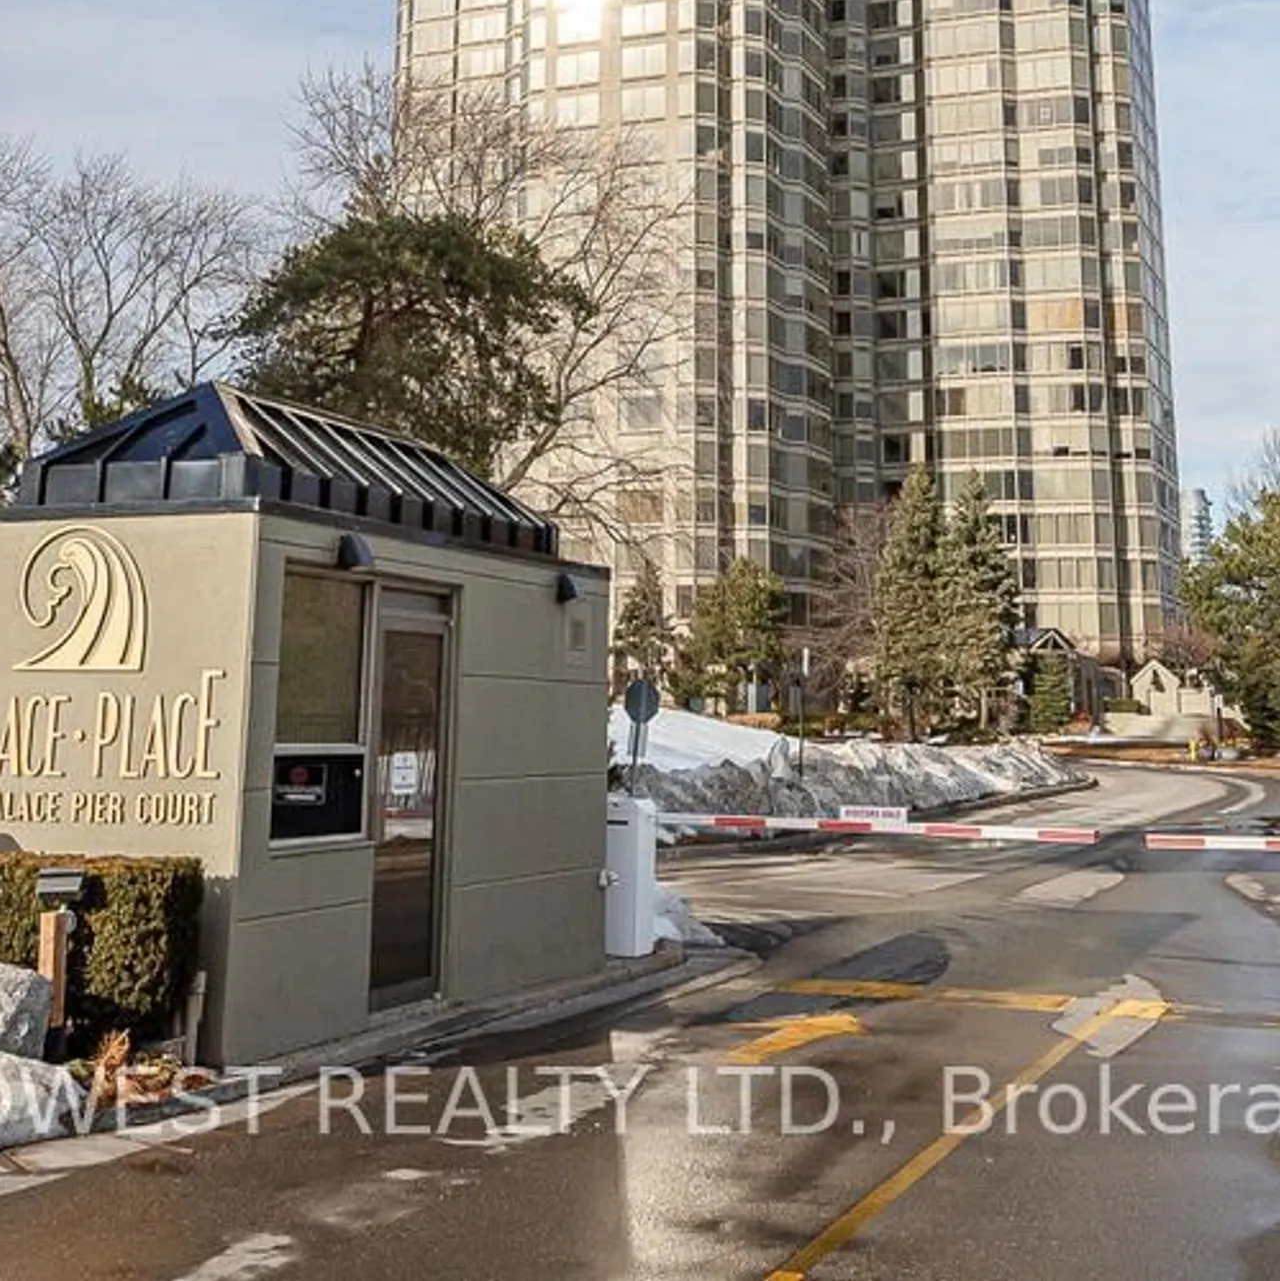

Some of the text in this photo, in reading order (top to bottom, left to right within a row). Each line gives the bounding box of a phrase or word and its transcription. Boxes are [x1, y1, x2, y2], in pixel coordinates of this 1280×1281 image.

[94, 668, 227, 781] PLACE
[70, 792, 125, 825] PIER
[136, 792, 218, 826] COURT
